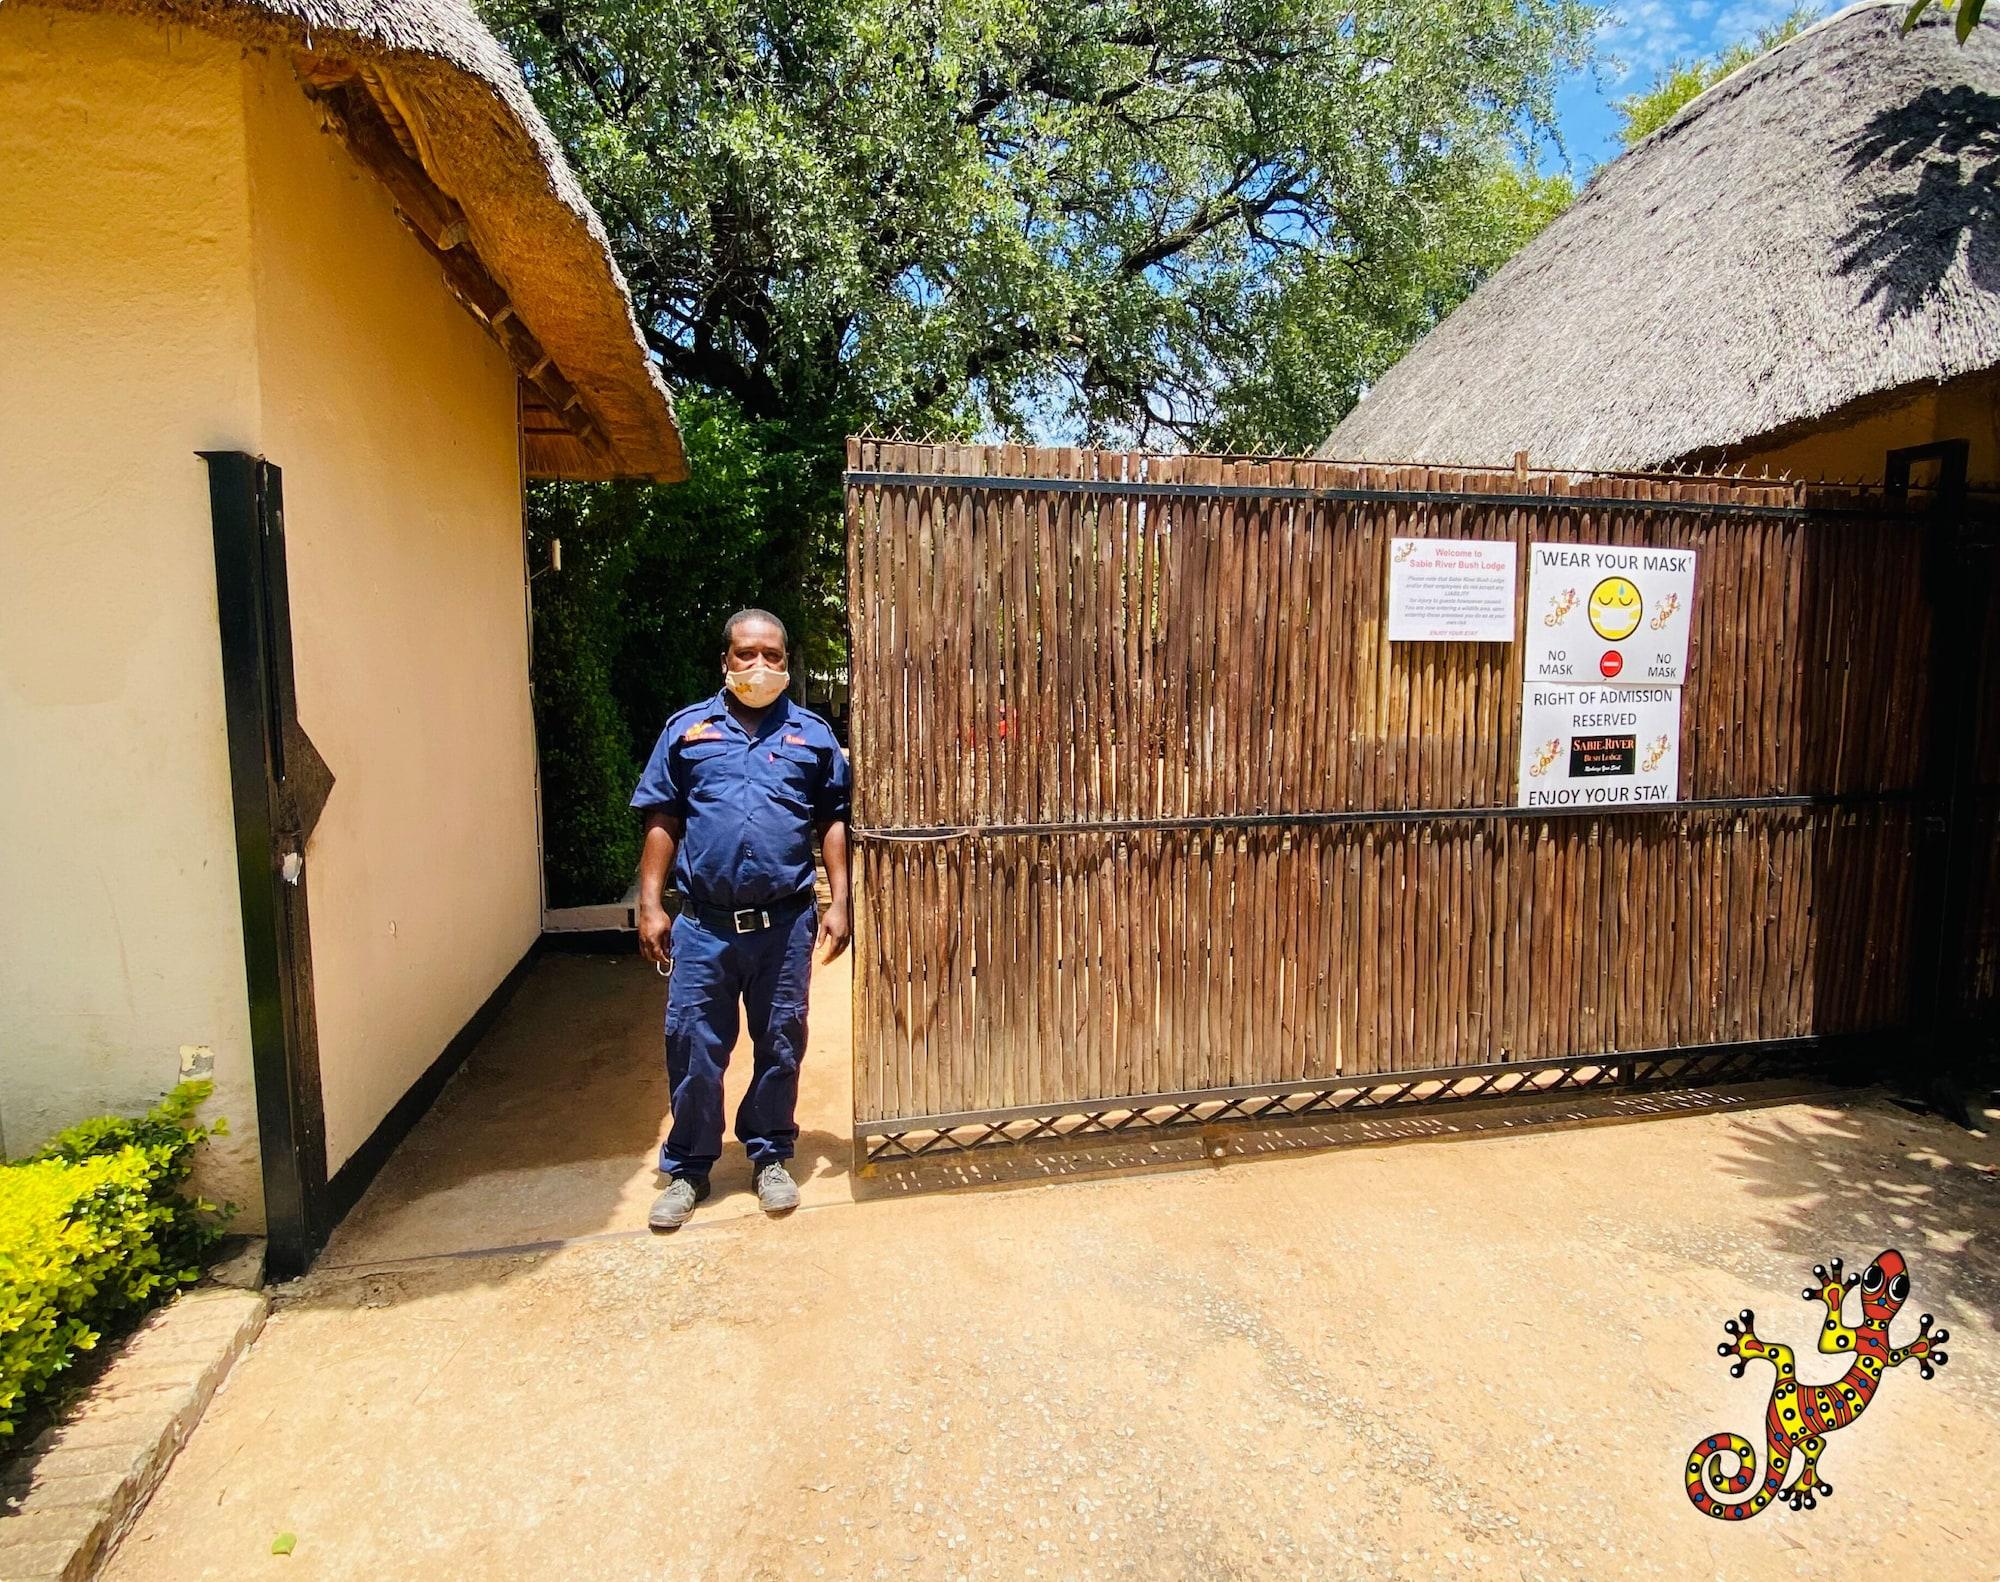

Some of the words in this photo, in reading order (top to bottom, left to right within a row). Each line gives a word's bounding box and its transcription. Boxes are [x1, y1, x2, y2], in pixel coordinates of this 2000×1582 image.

[1435, 548, 1472, 558] Welcome
[1474, 549, 1482, 558] to
[1409, 559, 1432, 568] Sabie
[1434, 560, 1456, 569] River
[1458, 560, 1479, 569] Bush
[1481, 561, 1505, 571] Lodge
[1542, 551, 1590, 568] WEAR
[1595, 553, 1638, 570] YOUR
[1643, 556, 1687, 572] MASK
[1548, 650, 1566, 662] NO
[1656, 653, 1672, 664] NO
[1539, 664, 1573, 675] MASK
[1647, 667, 1677, 678] MASK
[1534, 692, 1575, 706] RIGHT
[1579, 691, 1596, 705] OF
[1600, 689, 1672, 704] ADMISSION
[1573, 713, 1637, 727] RESERVED
[1605, 738, 1634, 750] RIVER
[1529, 789, 1580, 806] ENJOY
[1585, 787, 1629, 803] YOUR
[1634, 784, 1668, 800] STAY
